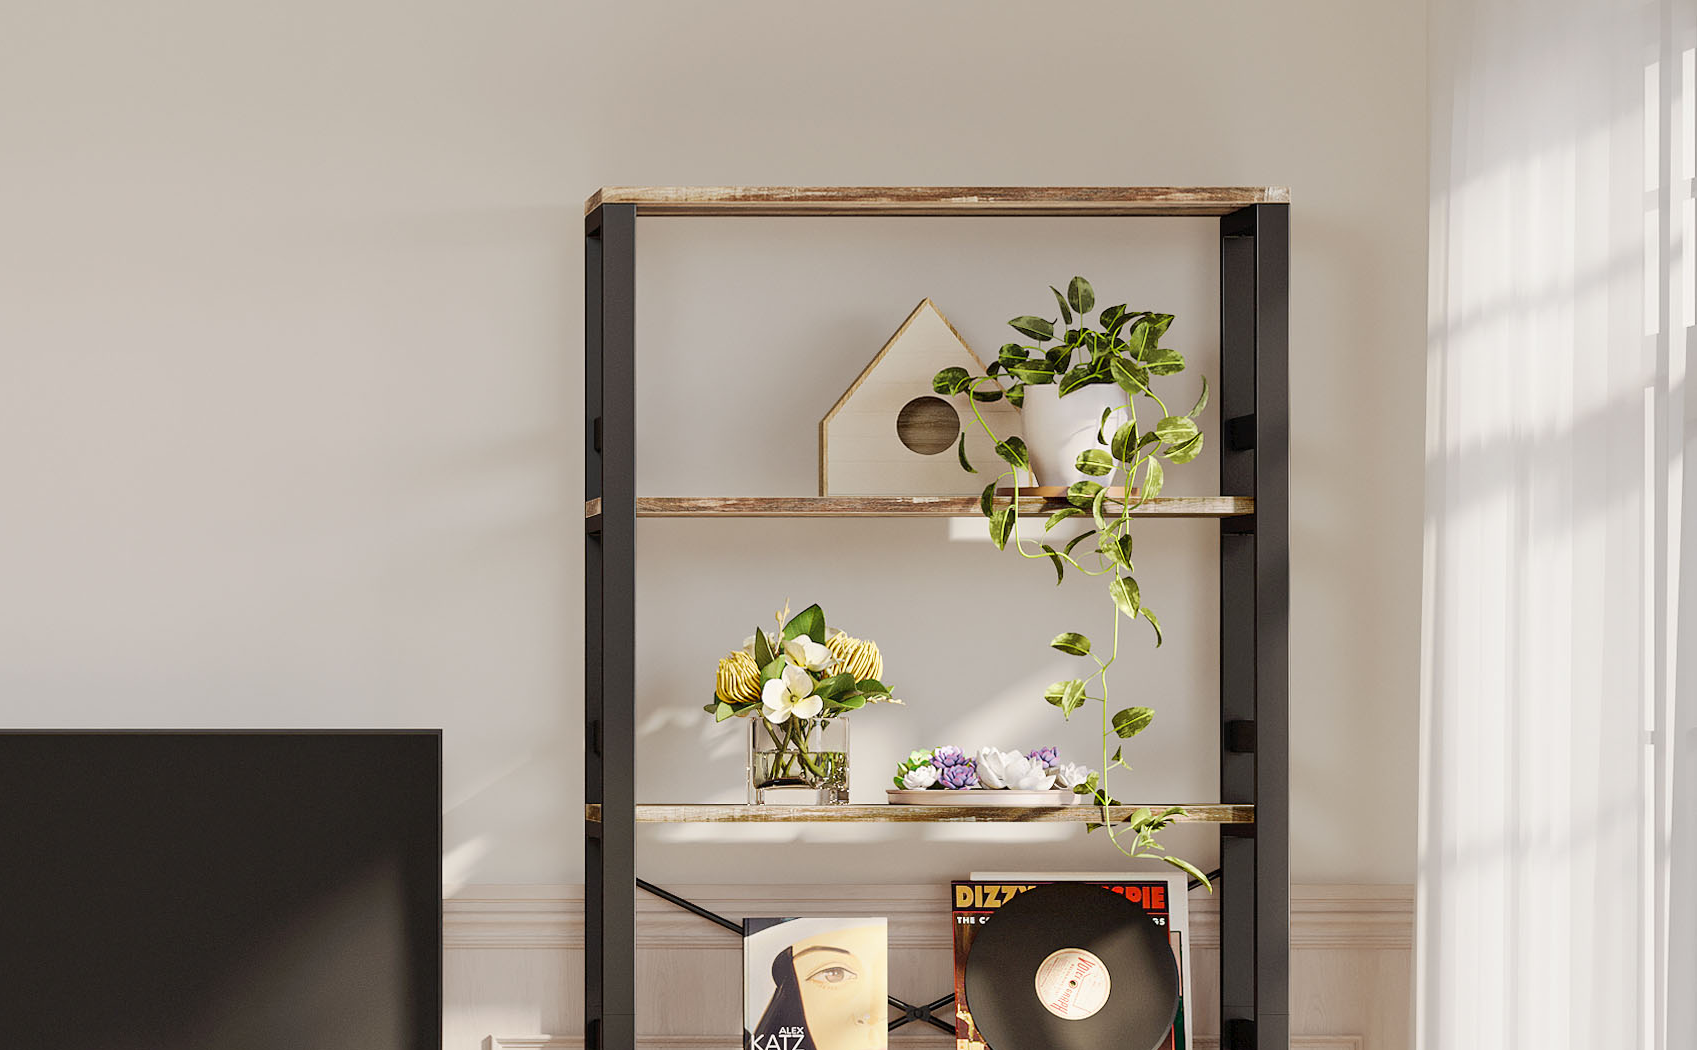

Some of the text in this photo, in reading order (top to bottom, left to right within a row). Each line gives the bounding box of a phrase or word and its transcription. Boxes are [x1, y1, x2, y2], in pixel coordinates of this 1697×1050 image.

[955, 885, 1037, 908] DIZZ
[956, 916, 976, 925] THE
[778, 1026, 805, 1035] ALEX
